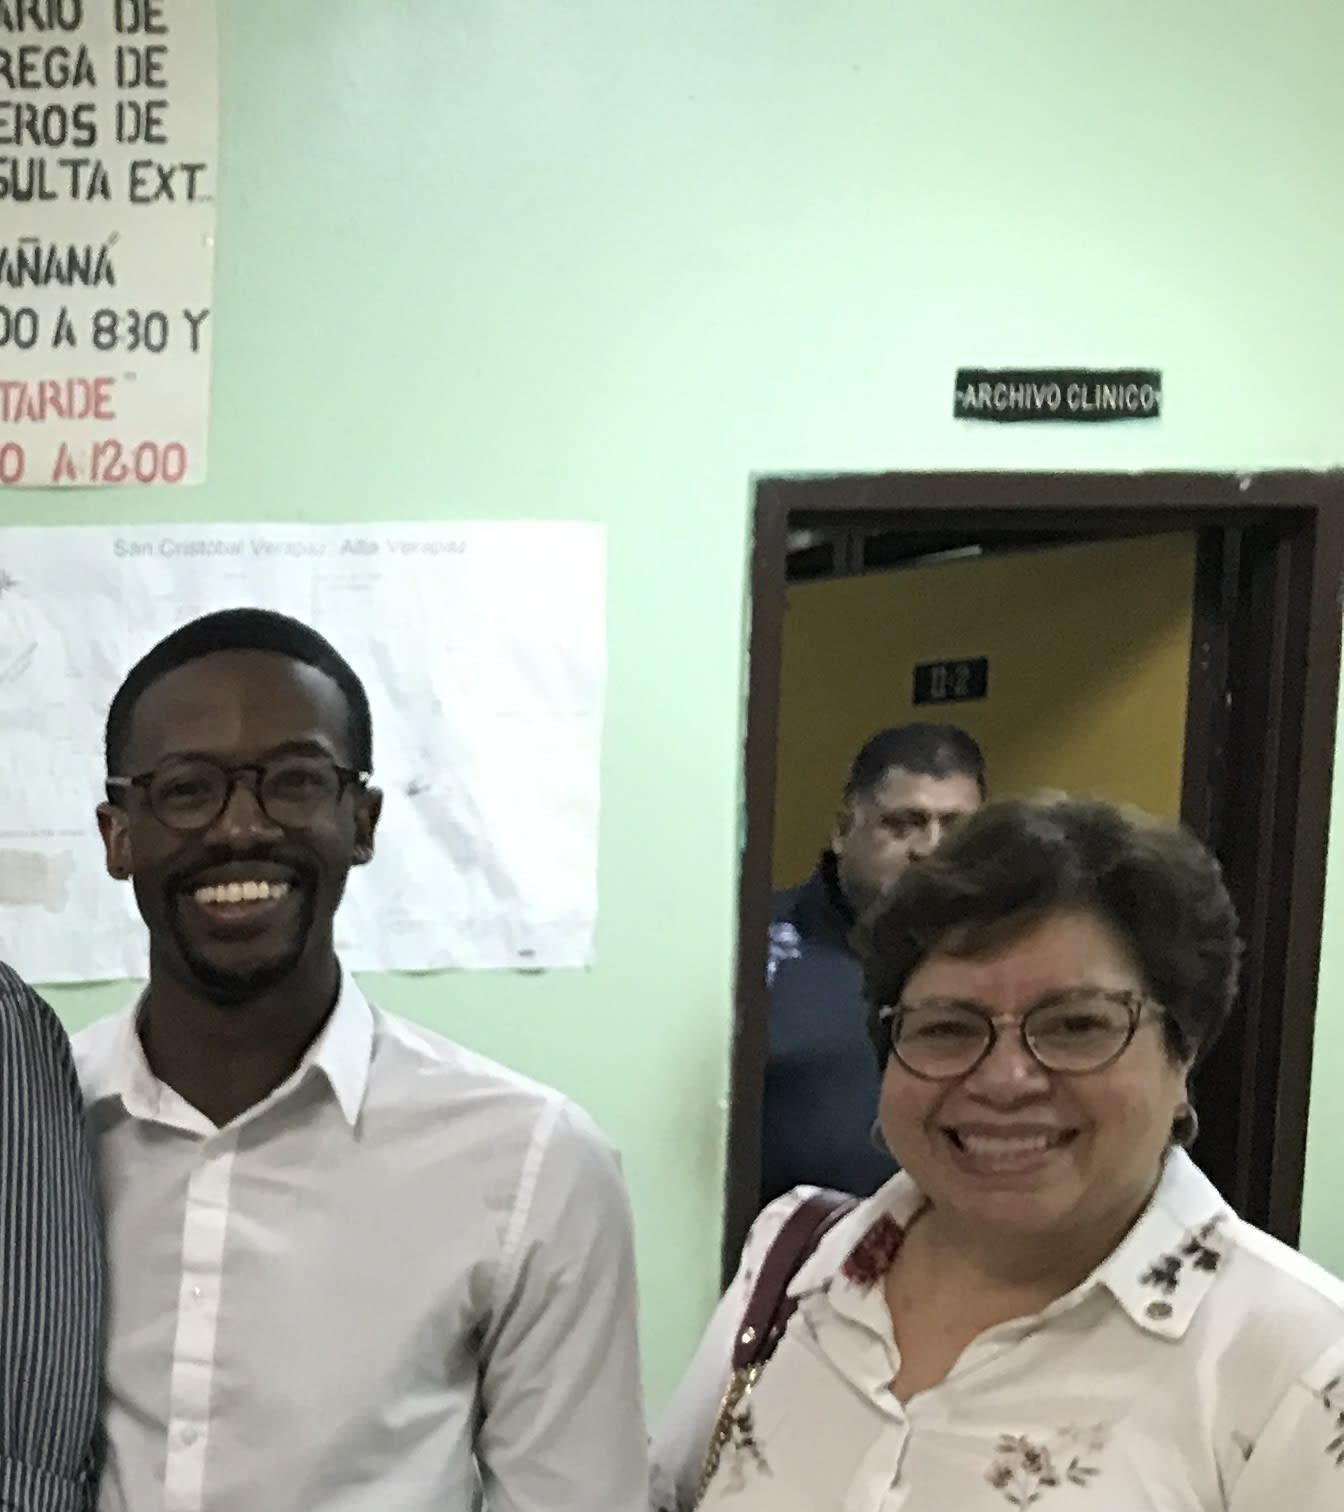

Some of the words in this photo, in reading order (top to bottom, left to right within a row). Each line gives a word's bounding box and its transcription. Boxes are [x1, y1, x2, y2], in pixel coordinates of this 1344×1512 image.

[114, 0, 169, 34] DE
[116, 45, 169, 89] DE
[115, 100, 169, 144] DE
[52, 305, 77, 348] A
[183, 308, 211, 353] Y
[963, 383, 1061, 411] ARCHIVO
[1067, 383, 1156, 411] CLINICO
